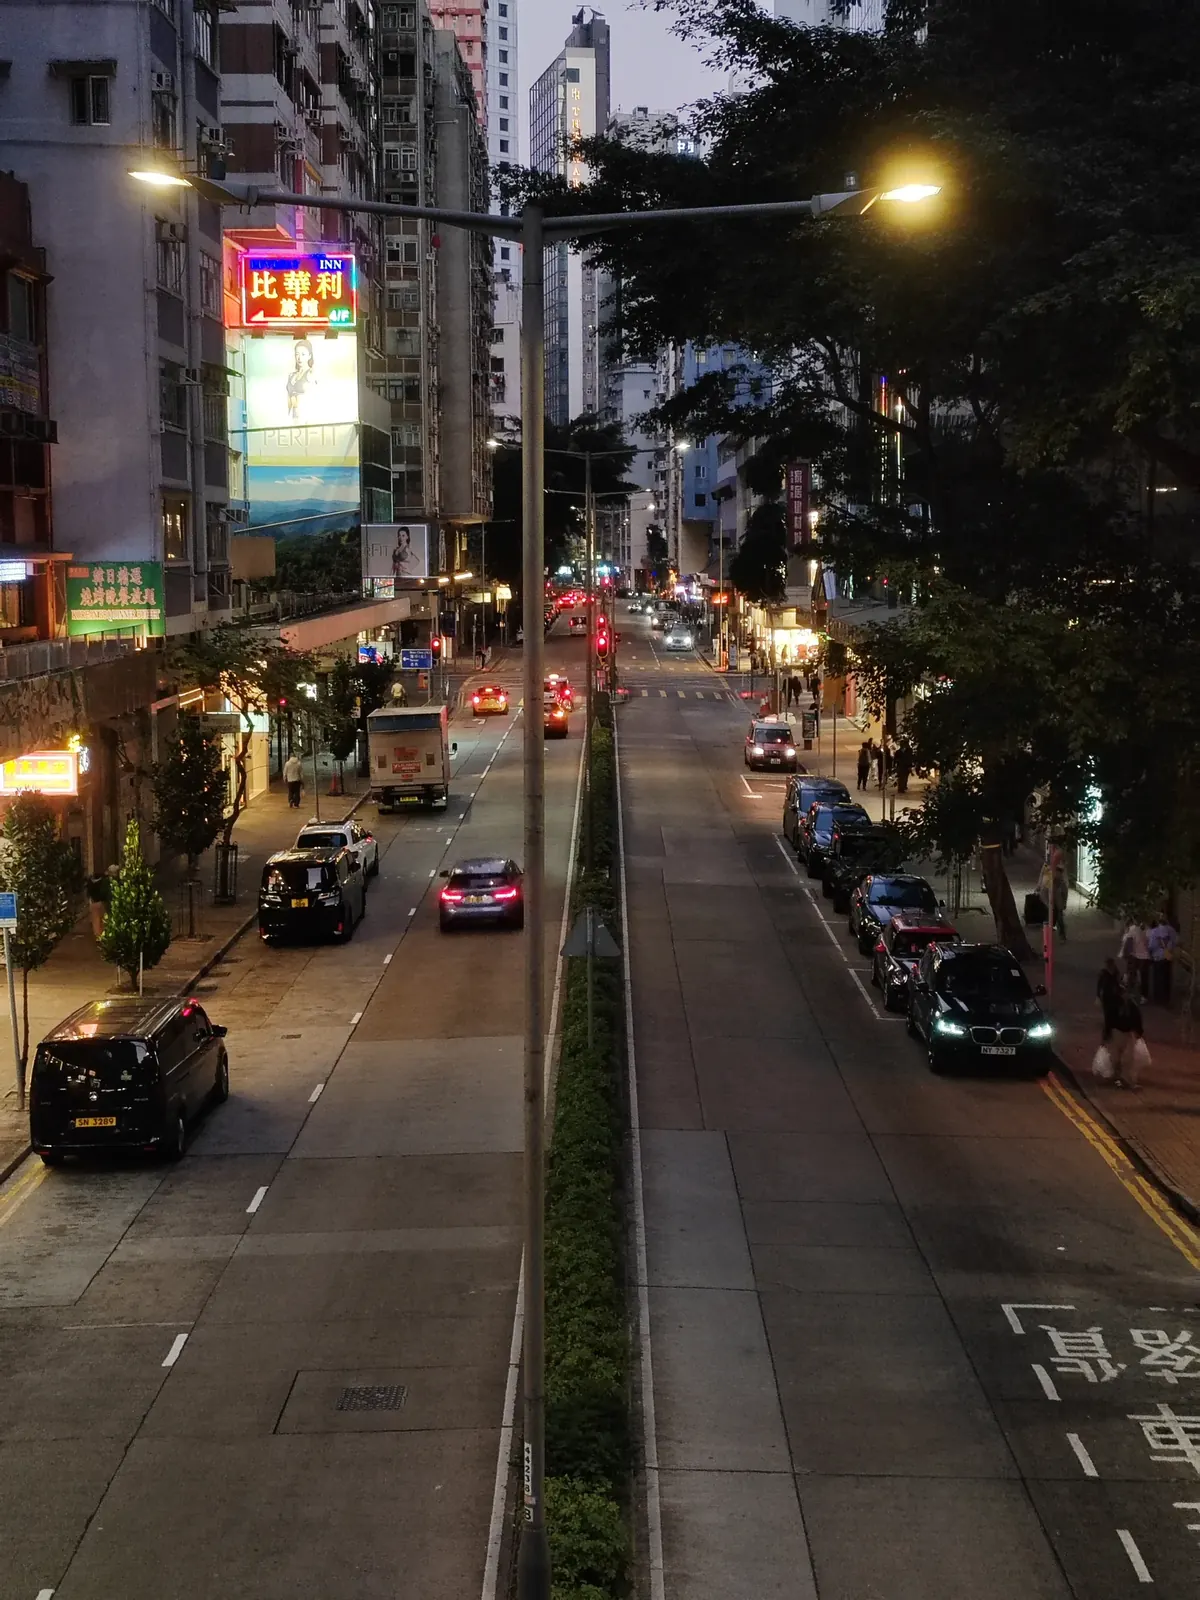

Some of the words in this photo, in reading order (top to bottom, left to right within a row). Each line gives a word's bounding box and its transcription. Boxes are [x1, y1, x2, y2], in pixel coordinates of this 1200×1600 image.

[320, 260, 342, 269] INN
[250, 270, 343, 299] 比華利
[329, 310, 350, 321] 4/F
[264, 426, 339, 446] PERFIT
[78, 1118, 89, 1126] SN
[93, 1117, 114, 1126] 3289
